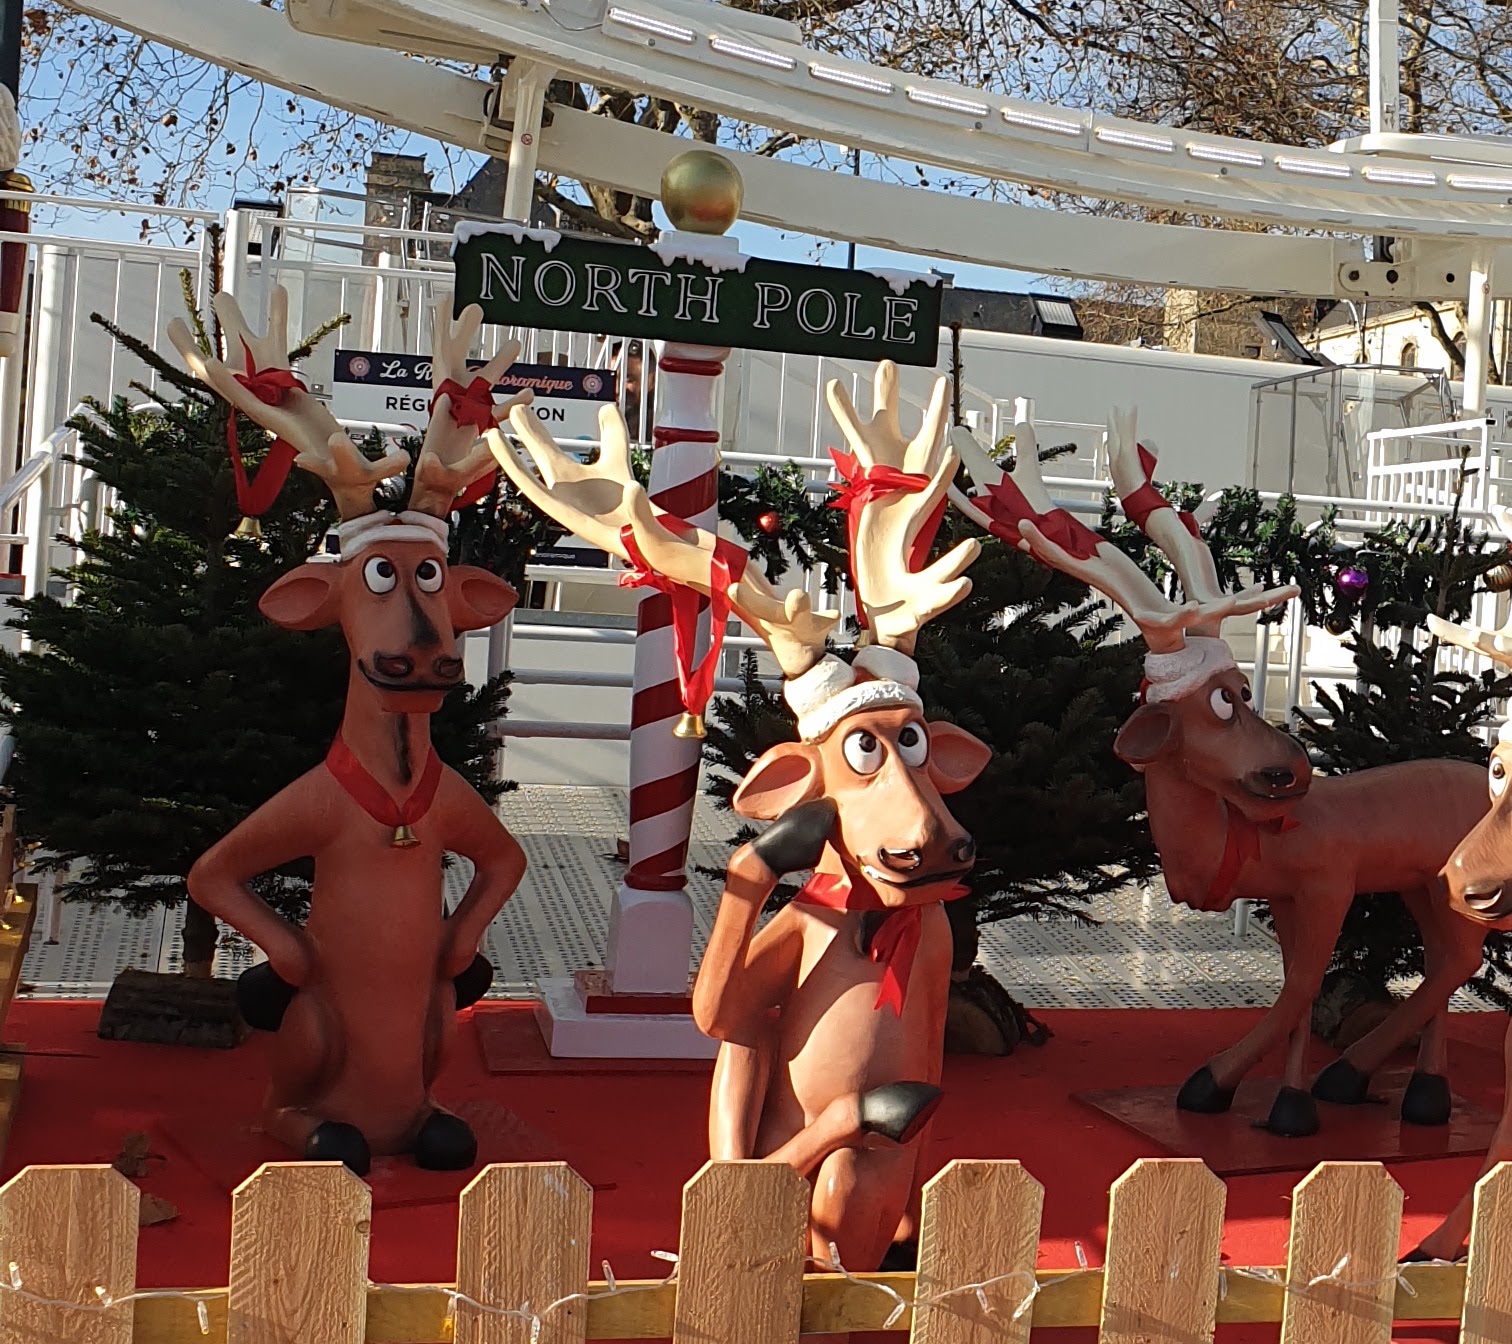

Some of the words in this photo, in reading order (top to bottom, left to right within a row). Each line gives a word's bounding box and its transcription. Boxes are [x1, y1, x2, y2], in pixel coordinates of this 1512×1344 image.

[480, 252, 724, 323] NORTH
[753, 282, 919, 344] POLE
[380, 360, 408, 378] La
